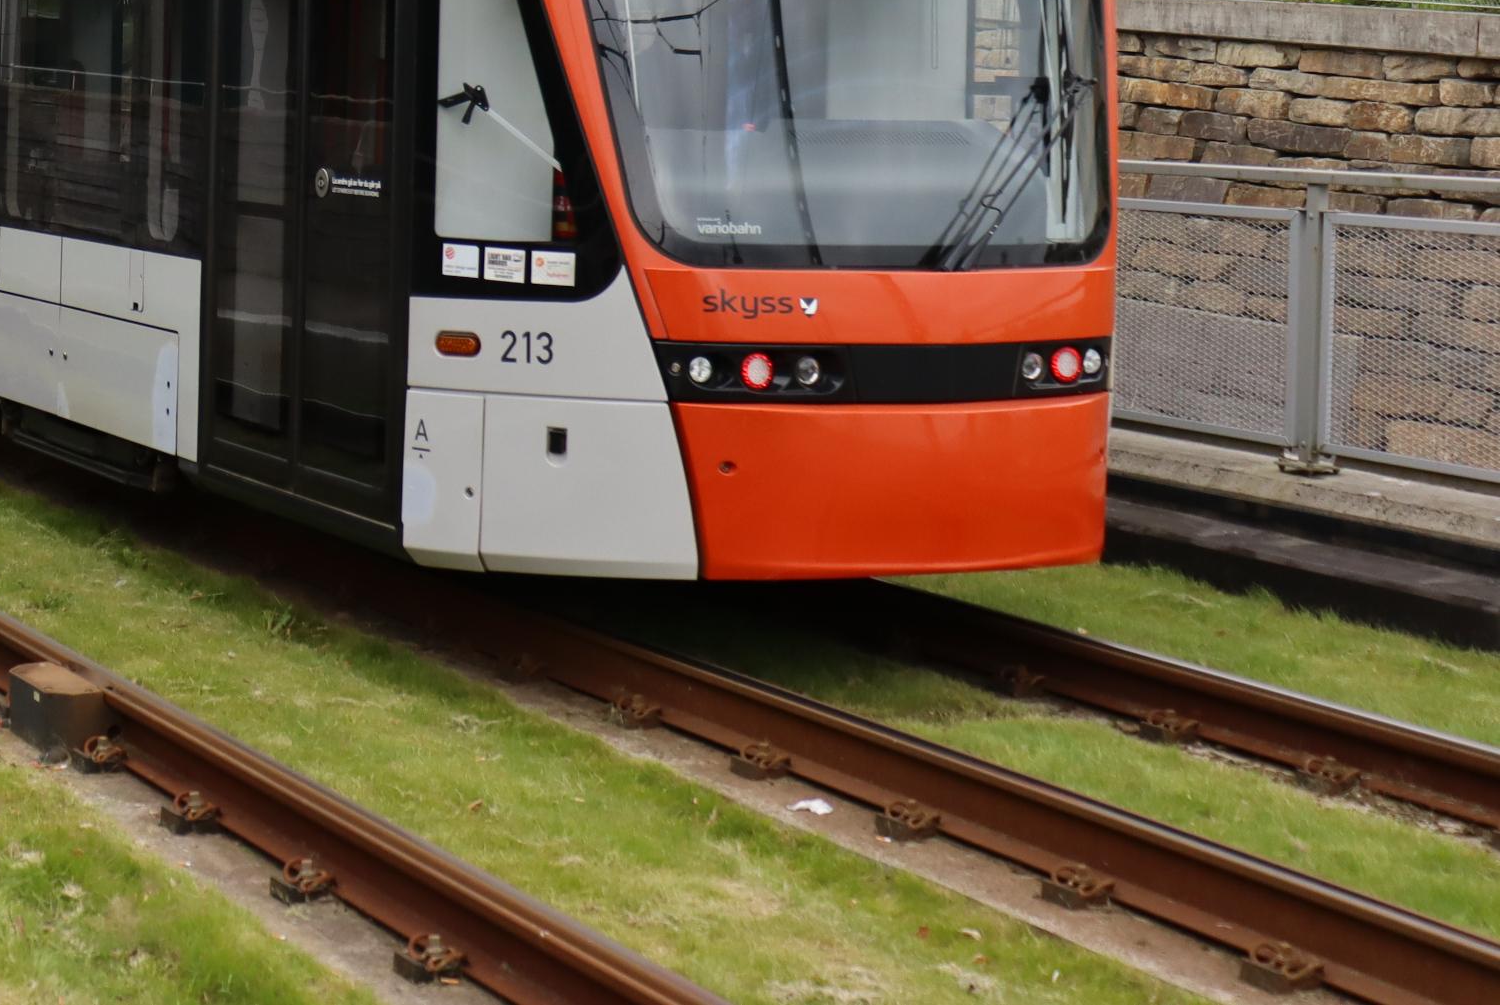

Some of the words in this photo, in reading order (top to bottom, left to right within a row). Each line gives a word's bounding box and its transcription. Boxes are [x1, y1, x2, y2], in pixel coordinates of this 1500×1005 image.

[697, 221, 762, 235] variobahn
[702, 288, 793, 319] skyss
[501, 330, 553, 365] 213
[415, 419, 428, 442] A
